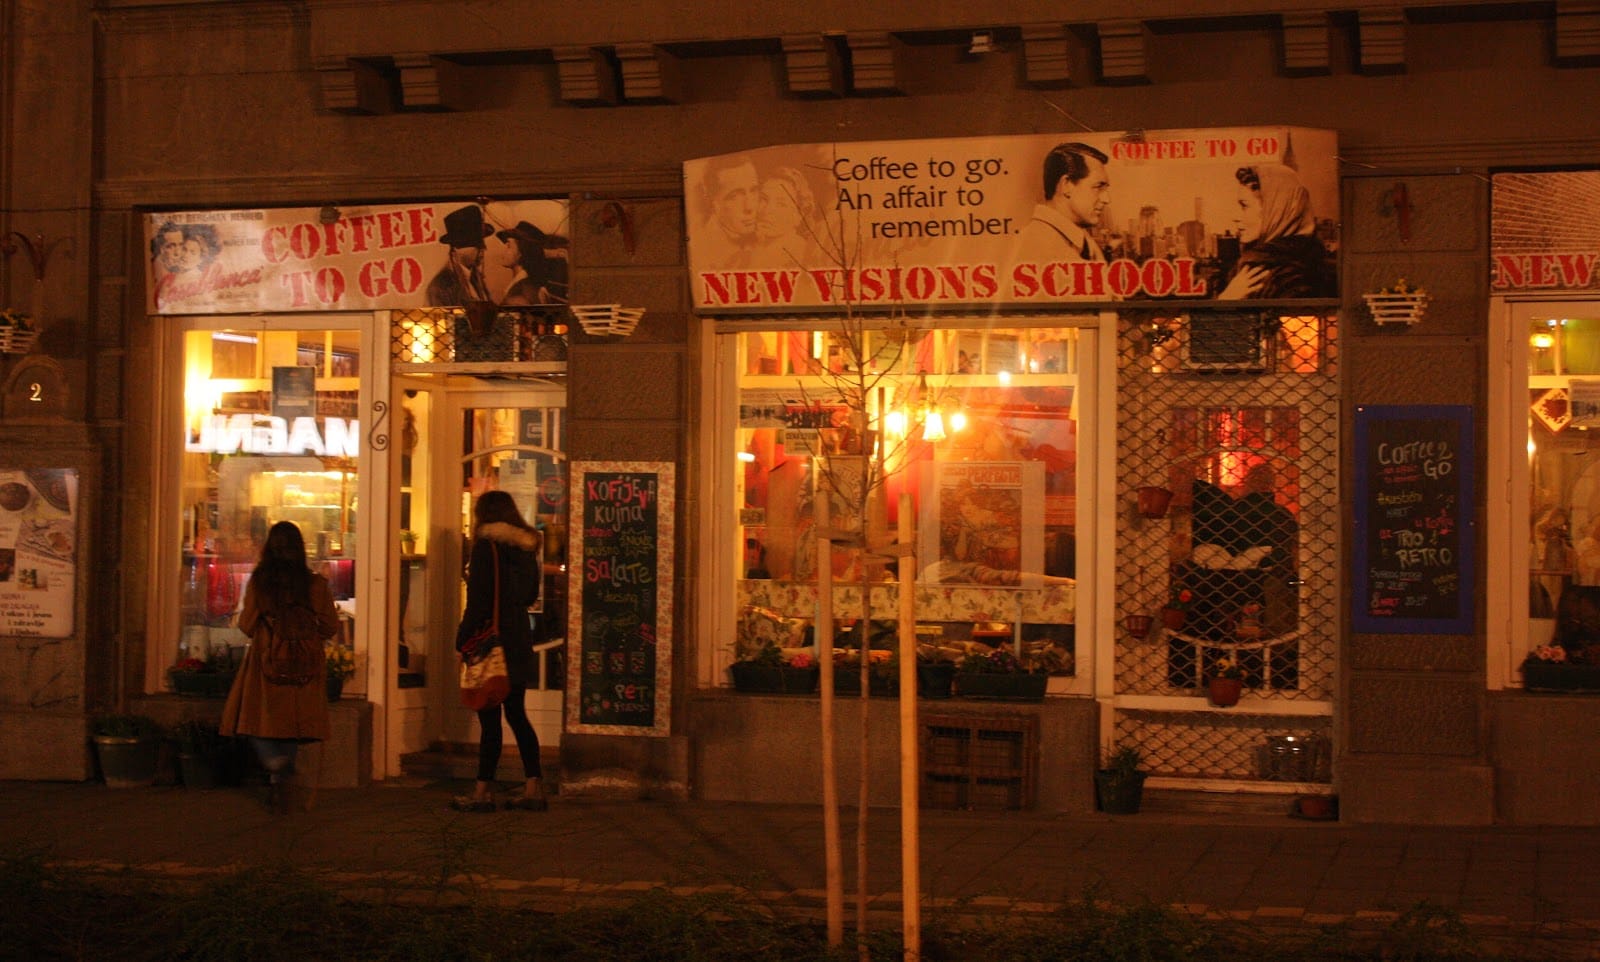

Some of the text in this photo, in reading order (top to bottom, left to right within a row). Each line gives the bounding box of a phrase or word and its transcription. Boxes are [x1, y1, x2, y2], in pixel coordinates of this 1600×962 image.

[1112, 137, 1279, 161] COFFEE TO GO
[832, 156, 1009, 184] Coffee to go.
[835, 185, 984, 211] An affair to
[261, 207, 437, 264] COFFEE
[871, 213, 1020, 239] remember.
[281, 257, 423, 308] TO GO
[701, 259, 1206, 305] NEW VISIONS SCHOOL
[1494, 254, 1597, 287] NEW
[29, 383, 42, 401] 2
[1438, 442, 1454, 460] 2
[1423, 459, 1452, 480] GO
[1395, 548, 1452, 570] RETRO
